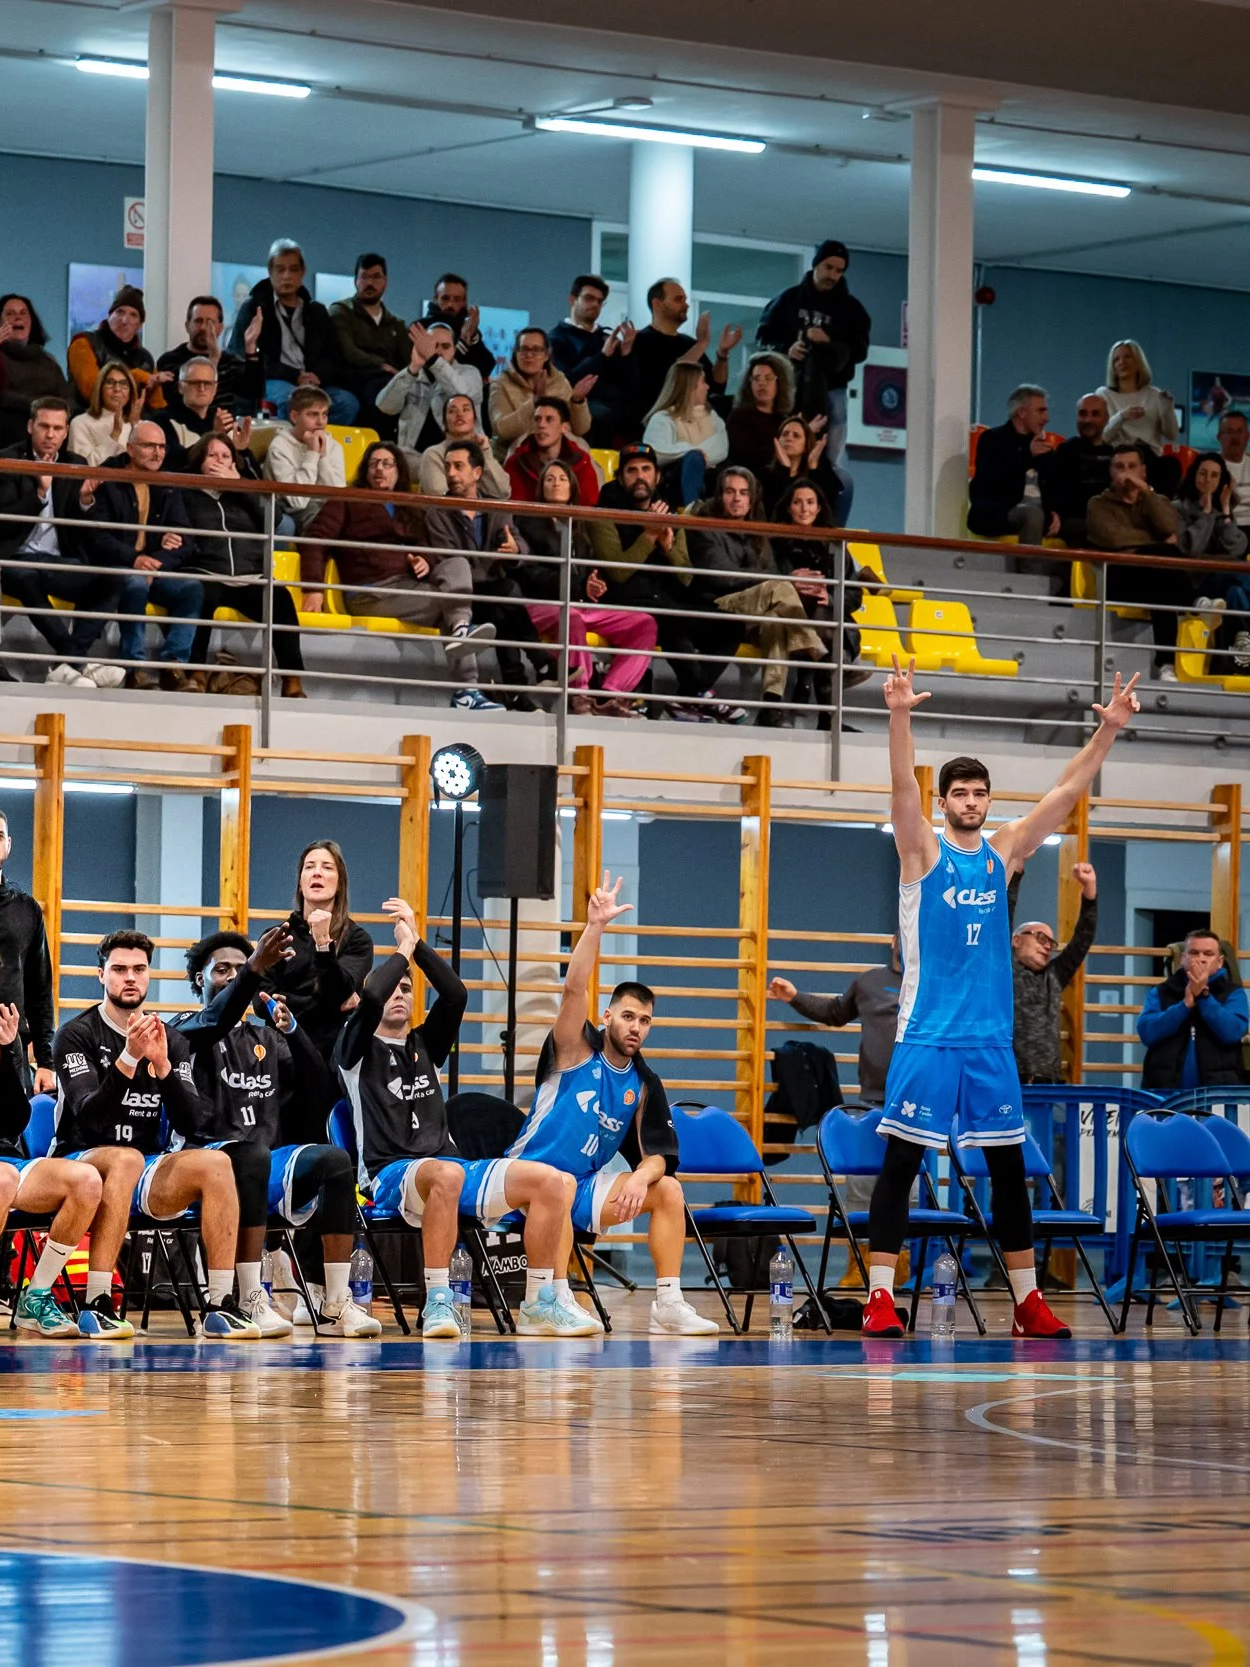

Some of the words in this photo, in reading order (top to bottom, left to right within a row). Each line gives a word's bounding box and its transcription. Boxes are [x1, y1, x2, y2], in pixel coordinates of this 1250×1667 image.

[966, 923, 982, 946] 17
[121, 1087, 162, 1108] lass
[129, 1109, 145, 1117] Rent
[240, 1104, 256, 1126] 11
[114, 1124, 133, 1142] 19
[580, 1133, 599, 1157] 10
